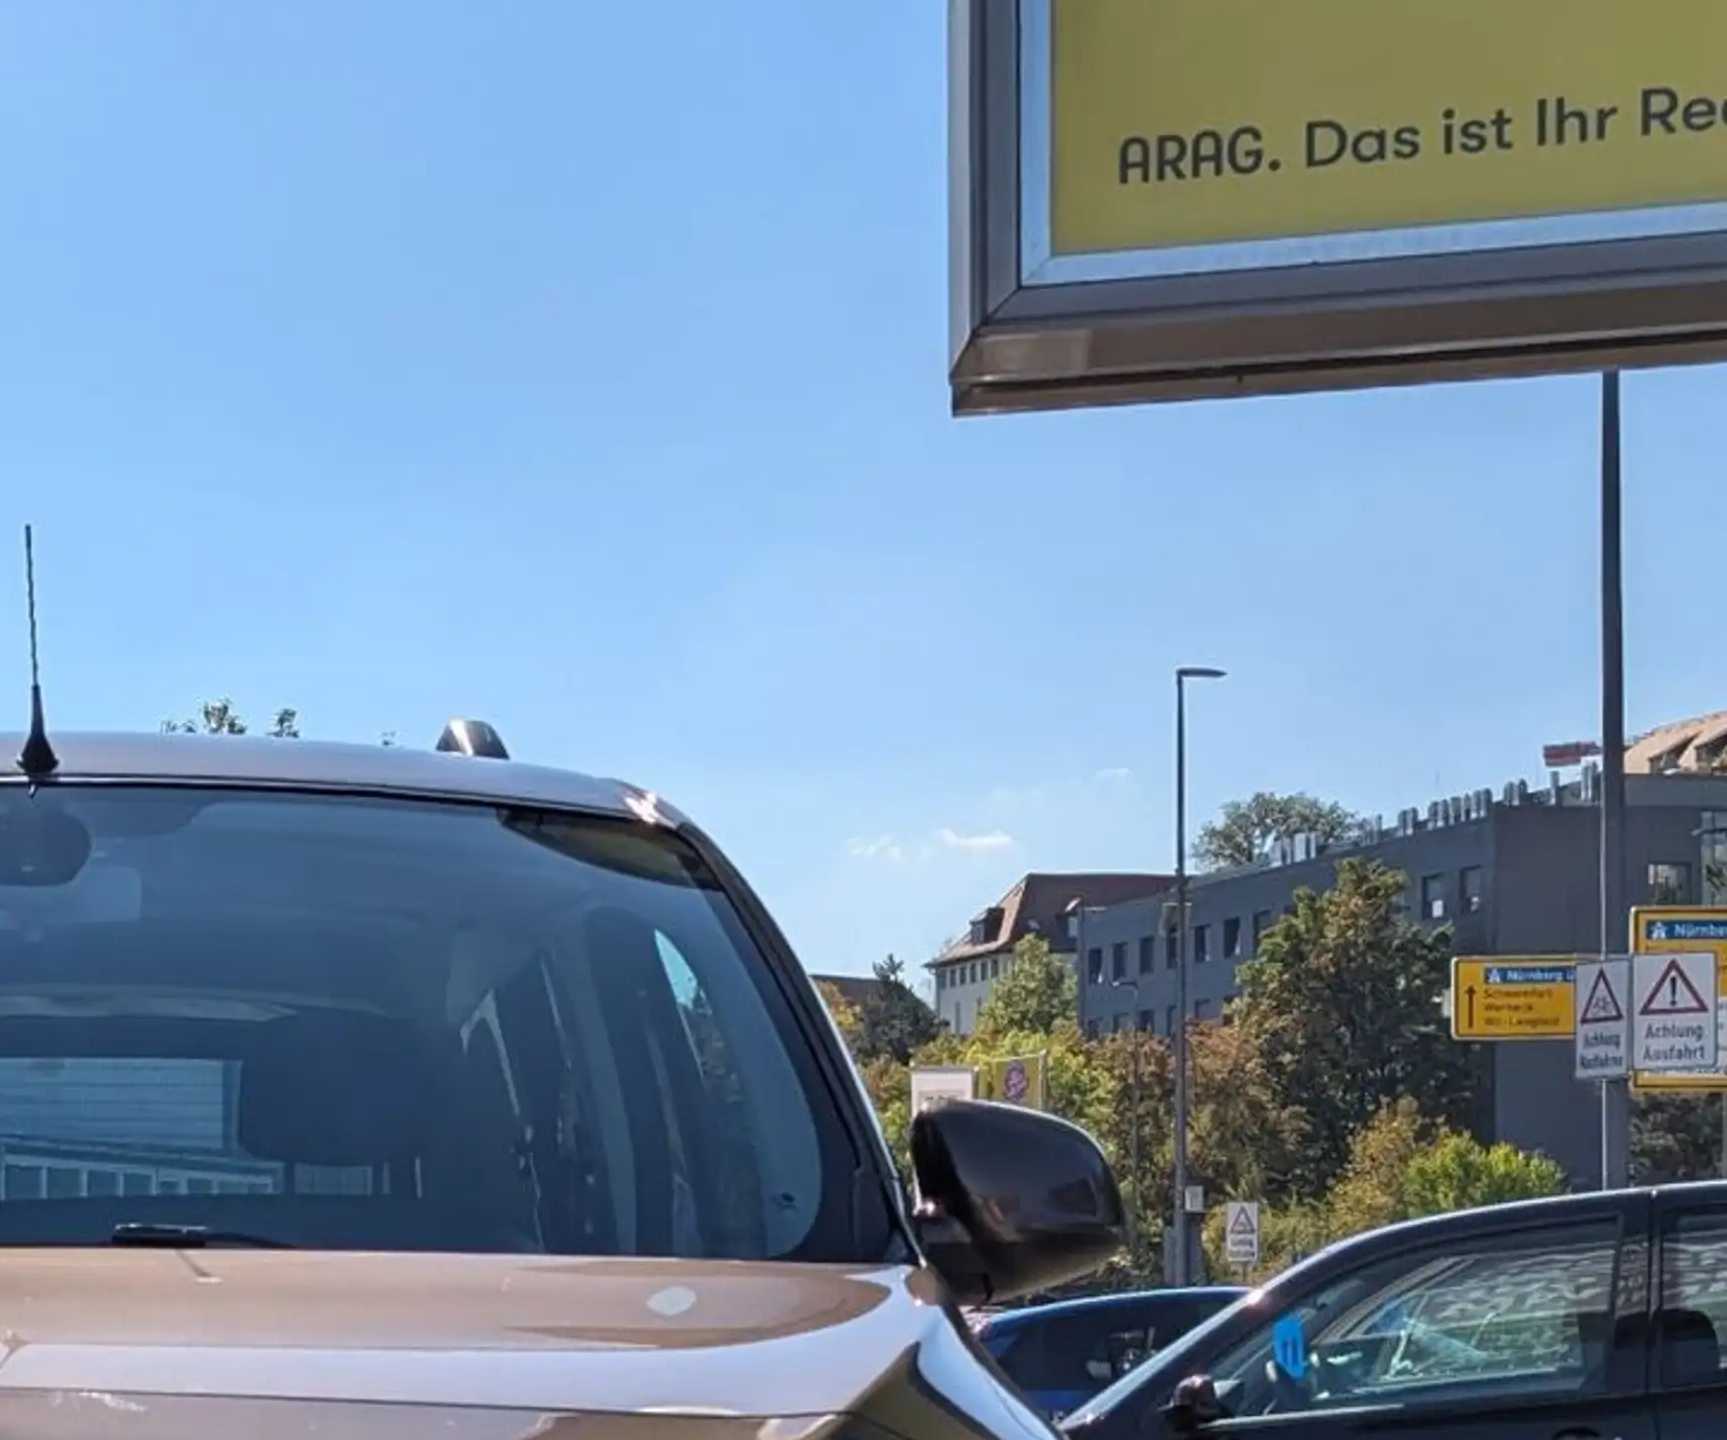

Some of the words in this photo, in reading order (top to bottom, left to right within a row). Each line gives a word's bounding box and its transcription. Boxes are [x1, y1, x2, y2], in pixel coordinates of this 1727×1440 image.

[1118, 126, 1282, 184] ARAG.
[1305, 119, 1420, 168] Das
[1442, 108, 1513, 156] ist
[1536, 97, 1618, 146] Ihr
[1641, 88, 1727, 136] Re
[1583, 1032, 1620, 1049] Achtung
[1645, 1023, 1704, 1041] Achtung
[1643, 1045, 1705, 1060] Ausfahrt
